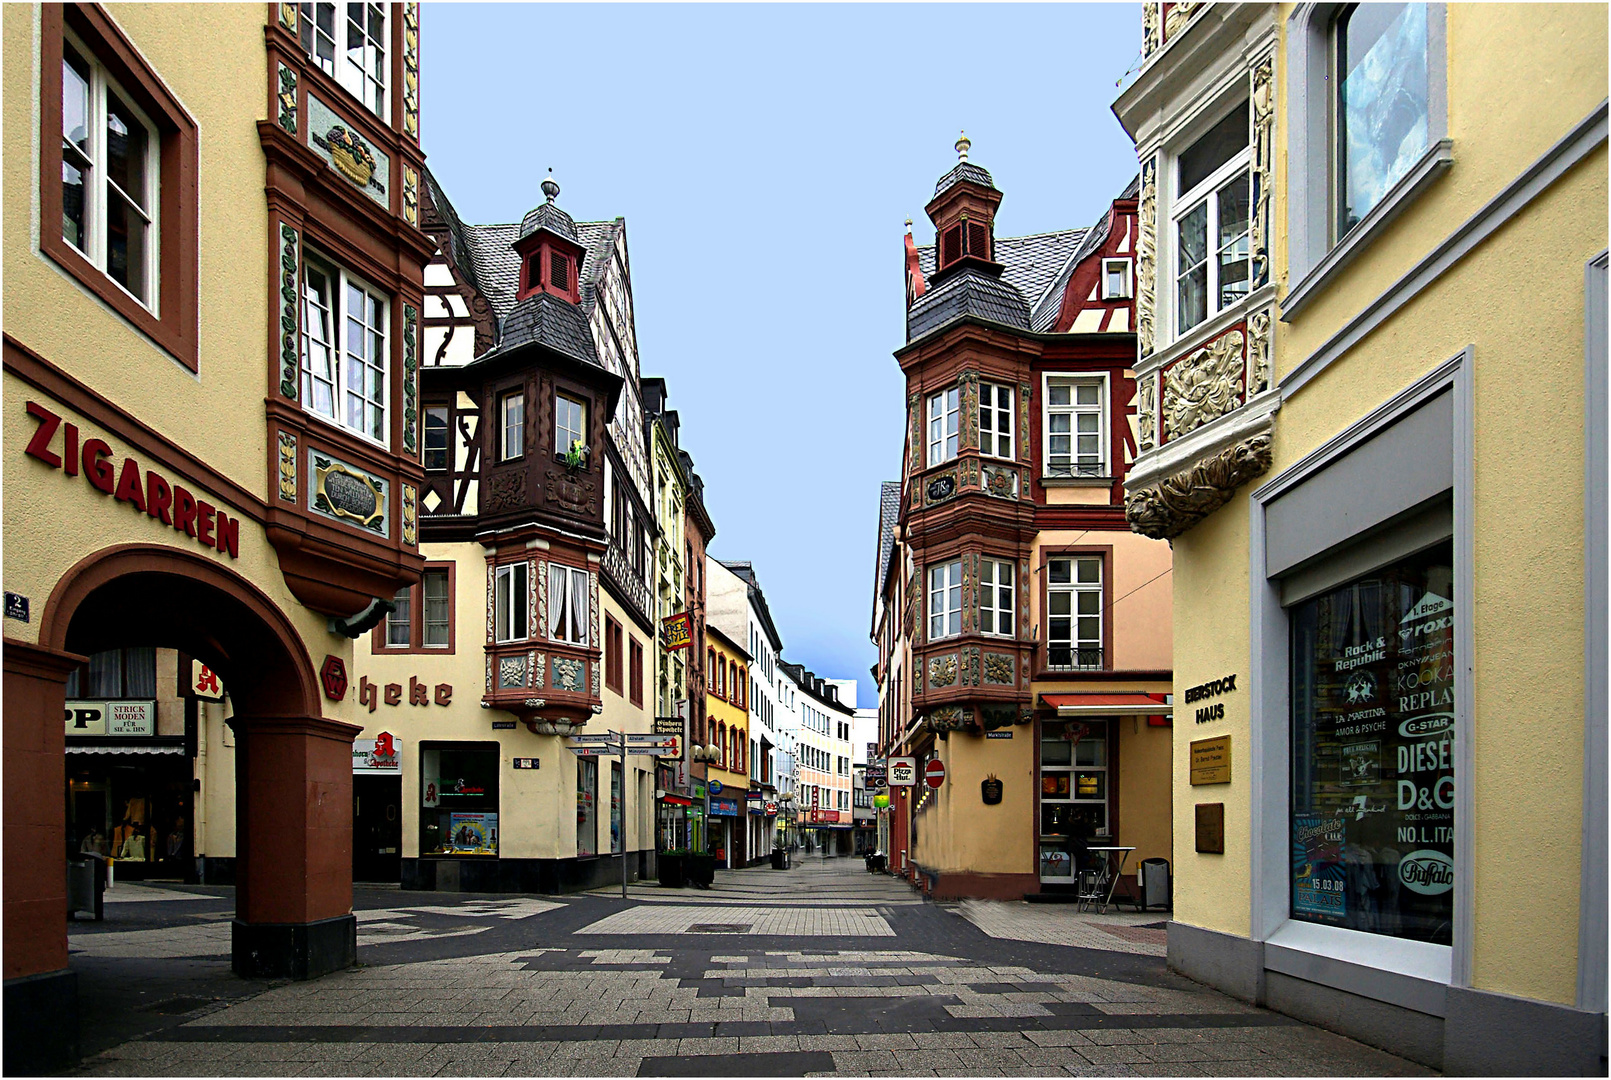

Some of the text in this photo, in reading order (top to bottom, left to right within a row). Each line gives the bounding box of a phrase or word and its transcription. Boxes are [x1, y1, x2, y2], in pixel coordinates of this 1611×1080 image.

[25, 401, 240, 559] ZIGARREN
[14, 595, 22, 608] 2
[1413, 600, 1444, 616] 1. Etage
[1345, 636, 1386, 658] Rock &
[1335, 650, 1386, 672] Republic
[1185, 674, 1236, 704] EIERSTOCK
[1196, 703, 1224, 724] HAUS
[1347, 706, 1386, 722] MARTINA
[1335, 721, 1386, 737] AMOR & PSYCHE
[1408, 718, 1448, 732] G-STAR
[1398, 776, 1454, 810] D&G
[1297, 819, 1342, 842] Chocolate
[1400, 857, 1454, 887] Buffalo
[1312, 878, 1344, 892] 15.03.08
[1298, 892, 1342, 906] PALAIS
